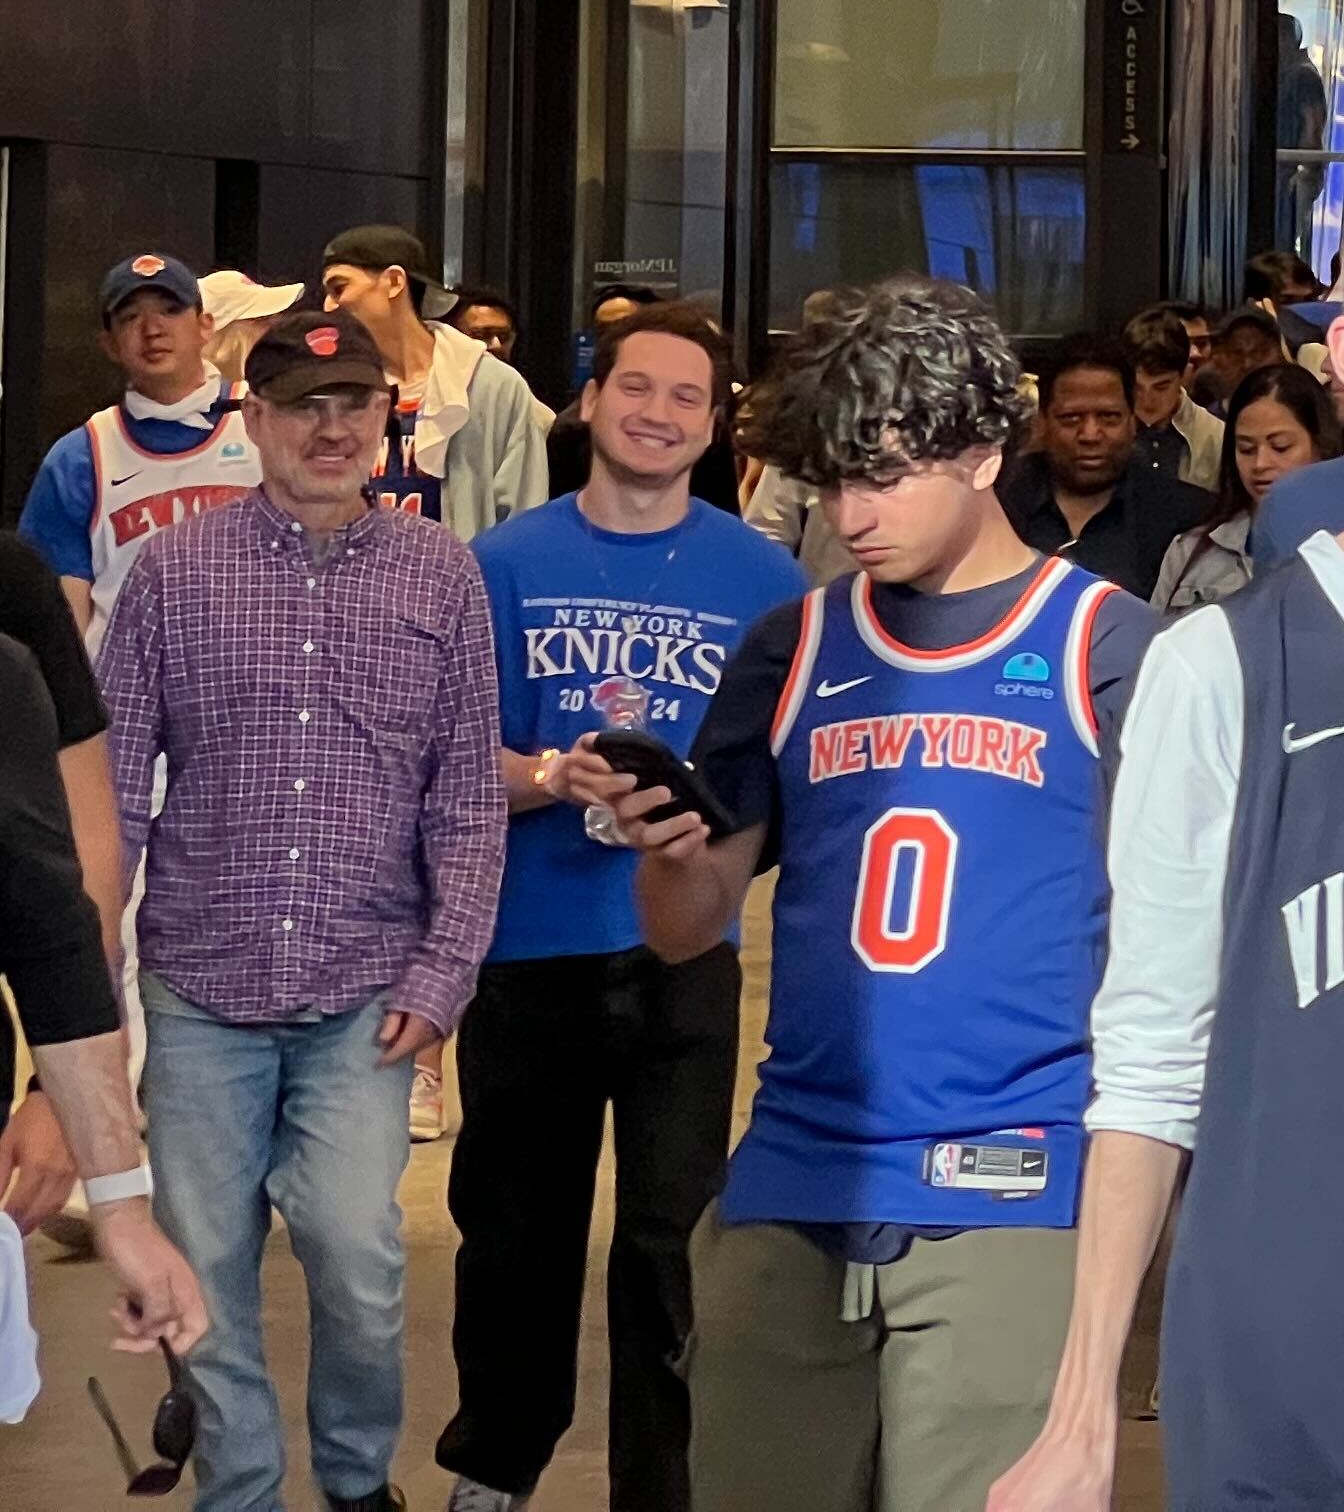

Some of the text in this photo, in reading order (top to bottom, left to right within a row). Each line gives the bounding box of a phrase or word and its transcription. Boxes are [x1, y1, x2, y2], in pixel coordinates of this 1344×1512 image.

[1125, 26, 1137, 130] ACCESS
[553, 609, 619, 627] NEW
[632, 615, 703, 640] YORK
[524, 628, 726, 696] KNICKS
[994, 682, 1054, 699] sphere
[559, 689, 681, 721] 20 24
[809, 713, 1047, 788] NEW YORK
[851, 807, 958, 974] 0
